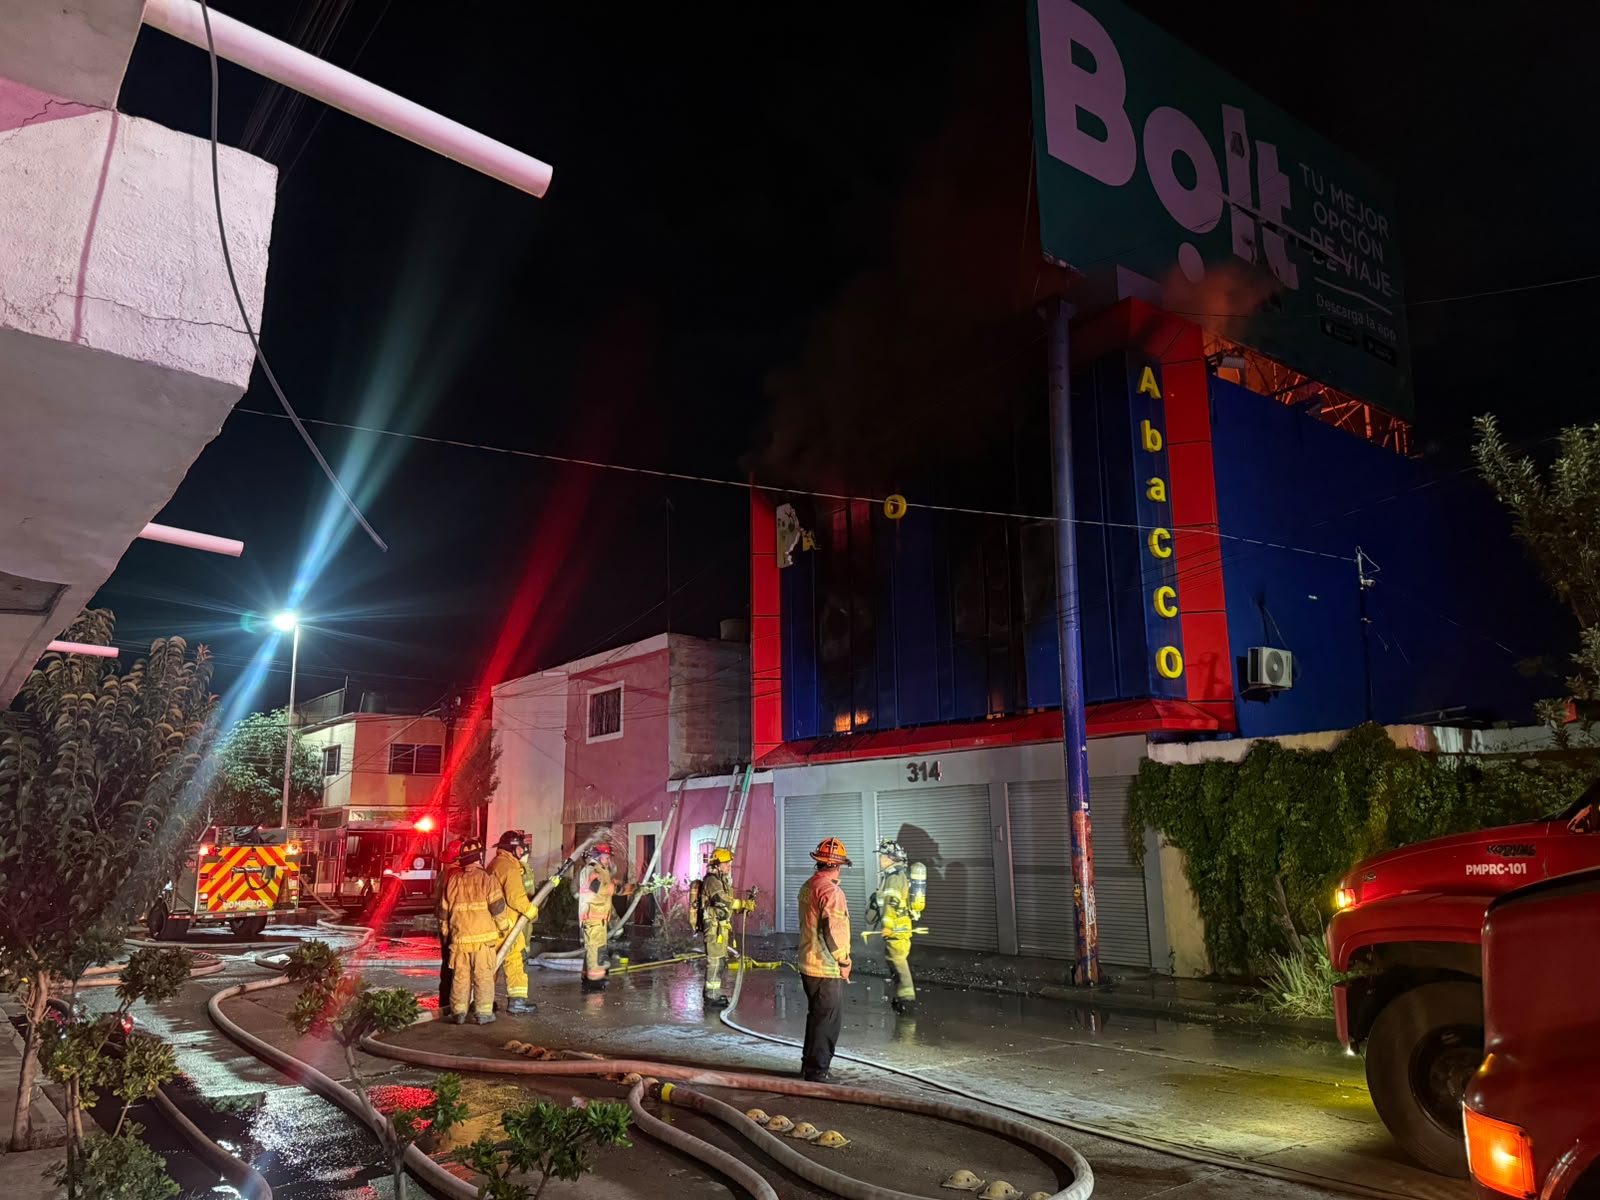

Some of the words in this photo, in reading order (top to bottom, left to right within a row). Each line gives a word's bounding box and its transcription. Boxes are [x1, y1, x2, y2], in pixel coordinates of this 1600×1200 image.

[1038, 0, 1299, 290] Bolt
[1299, 162, 1324, 196] TU
[1329, 183, 1390, 241] MEJOR
[1313, 201, 1384, 265] OPCIÓN
[1340, 245, 1392, 298] VIAJE
[1316, 293, 1364, 325] Descarga
[1366, 313, 1375, 329] la
[1377, 323, 1397, 344] app
[906, 761, 942, 783] 314
[1465, 862, 1527, 876] PMPRC-101
